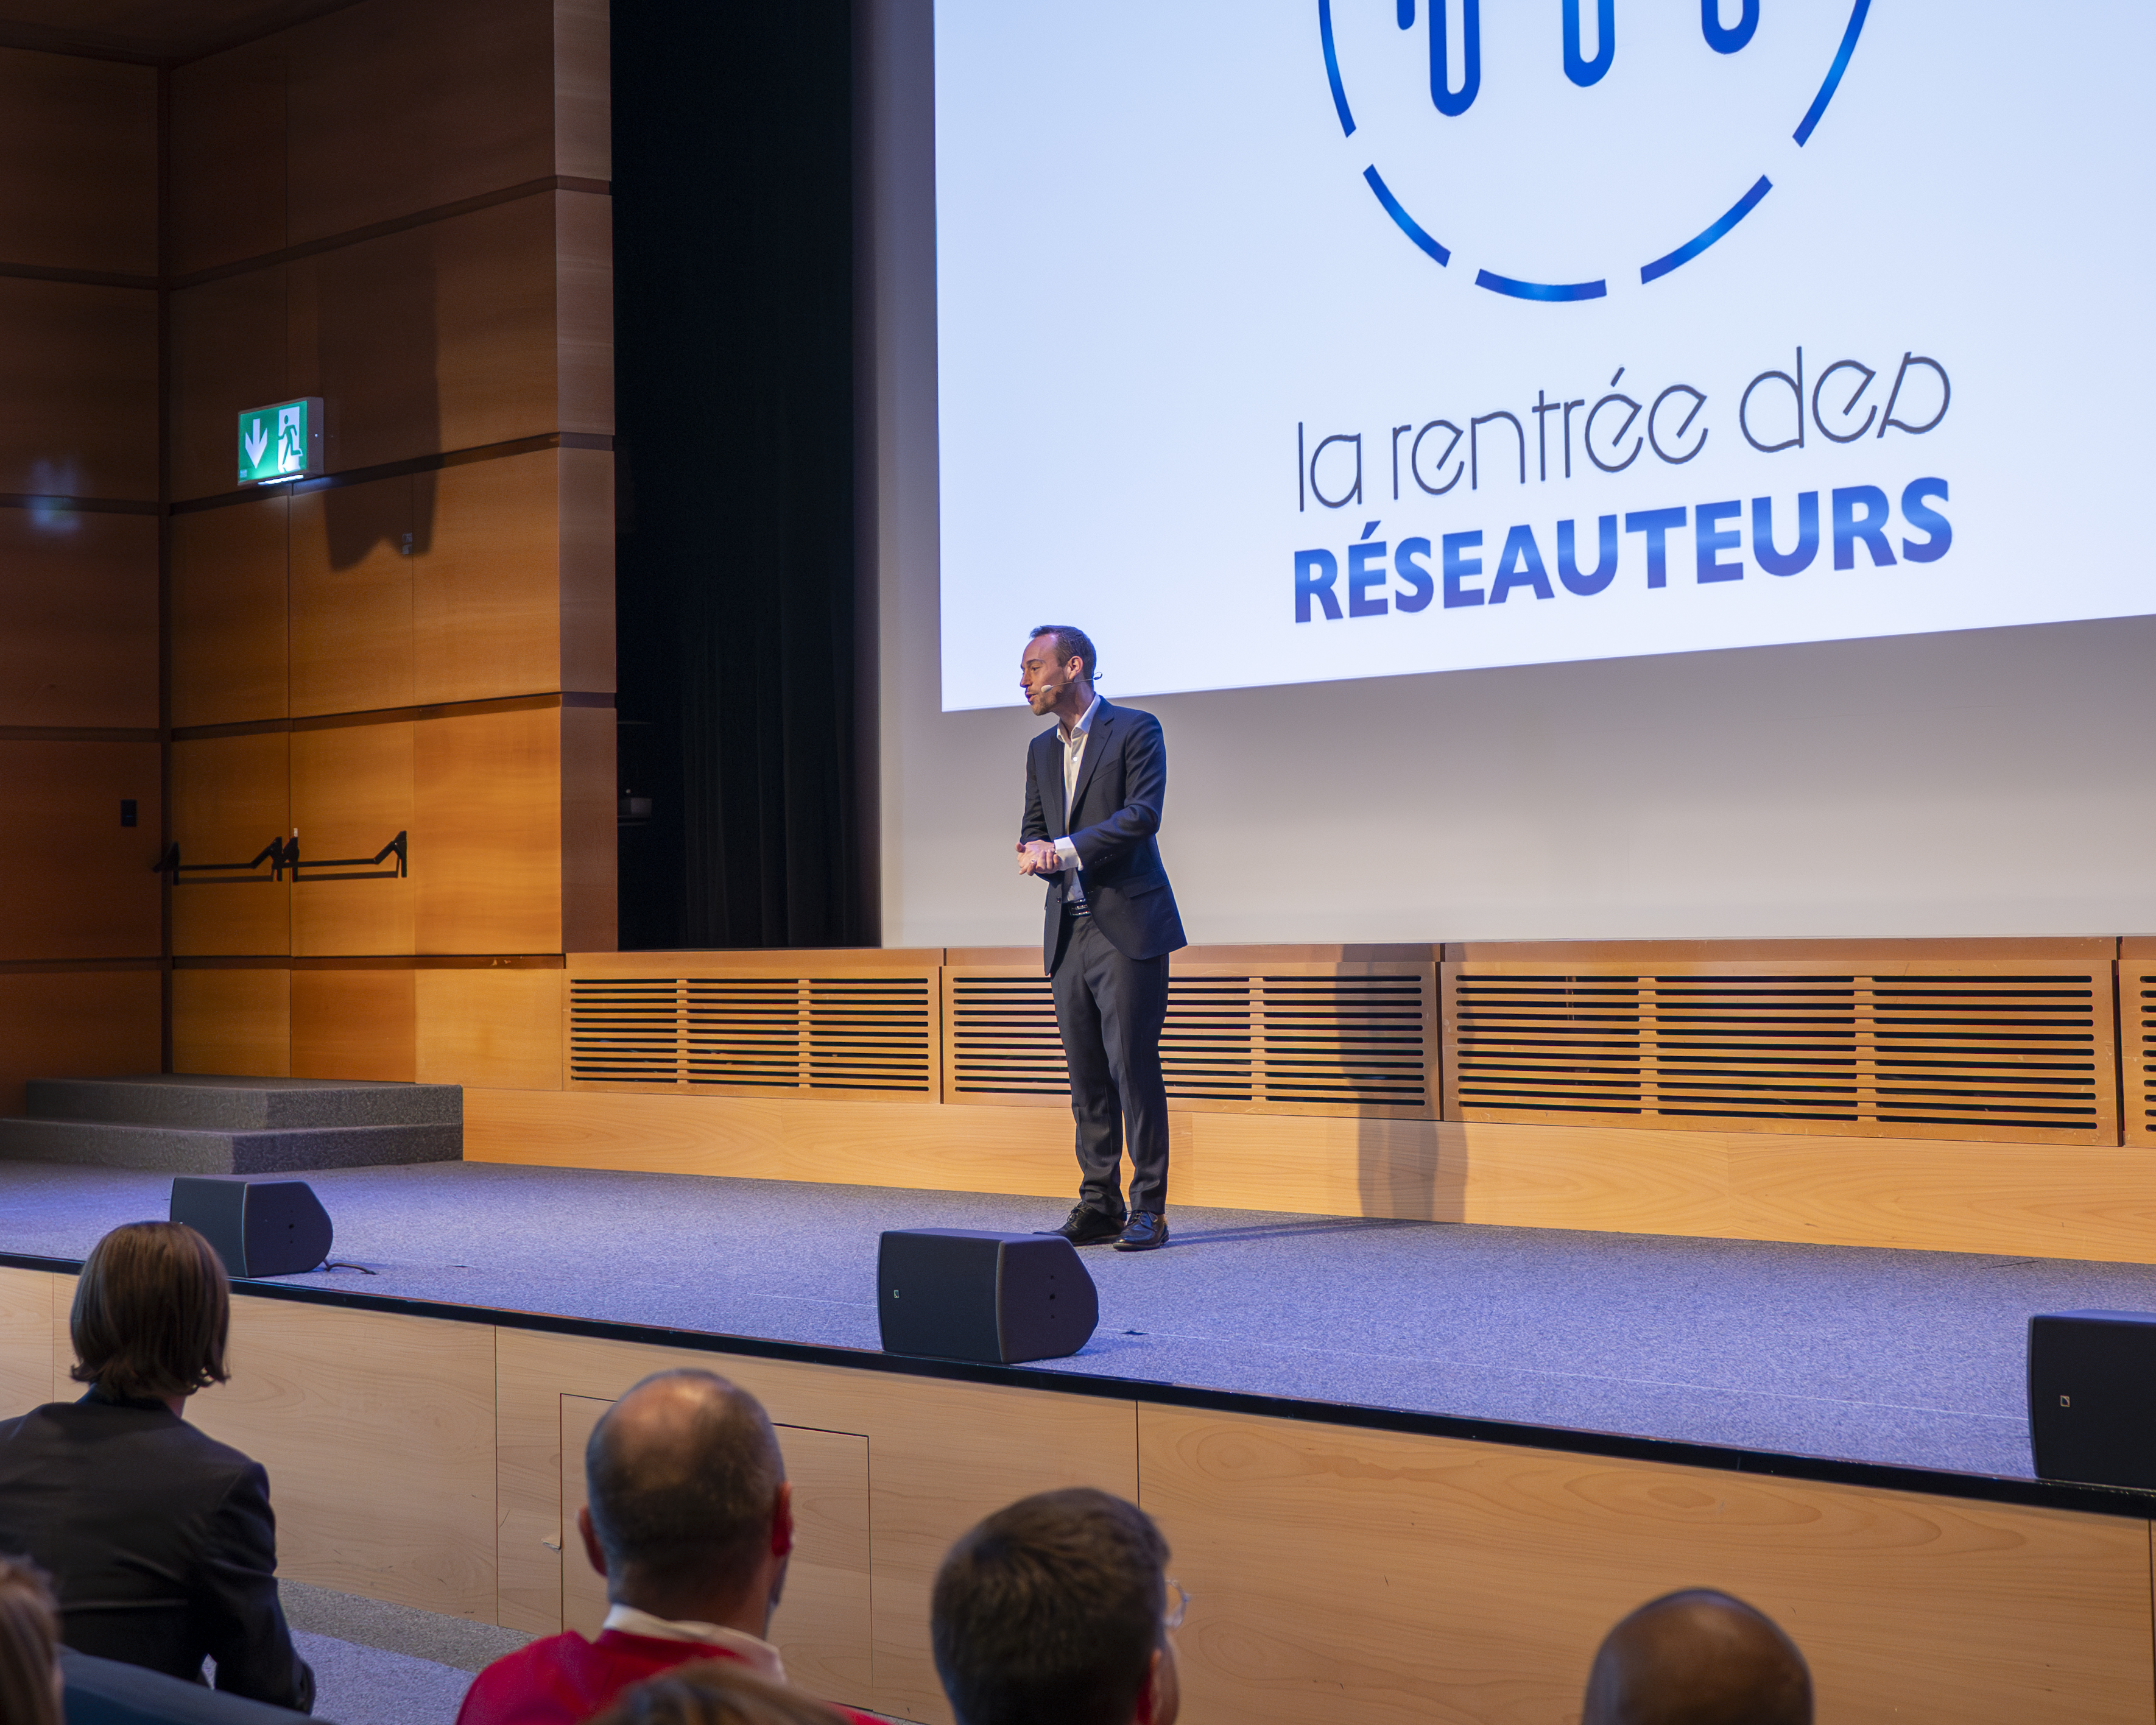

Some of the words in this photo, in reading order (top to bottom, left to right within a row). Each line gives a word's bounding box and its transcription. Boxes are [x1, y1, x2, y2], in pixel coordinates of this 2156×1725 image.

[1298, 421, 1363, 513] la
[1392, 367, 1709, 501] rentrée
[1739, 345, 1952, 454] des
[1294, 476, 1953, 622] RÉSEAUTEURS
